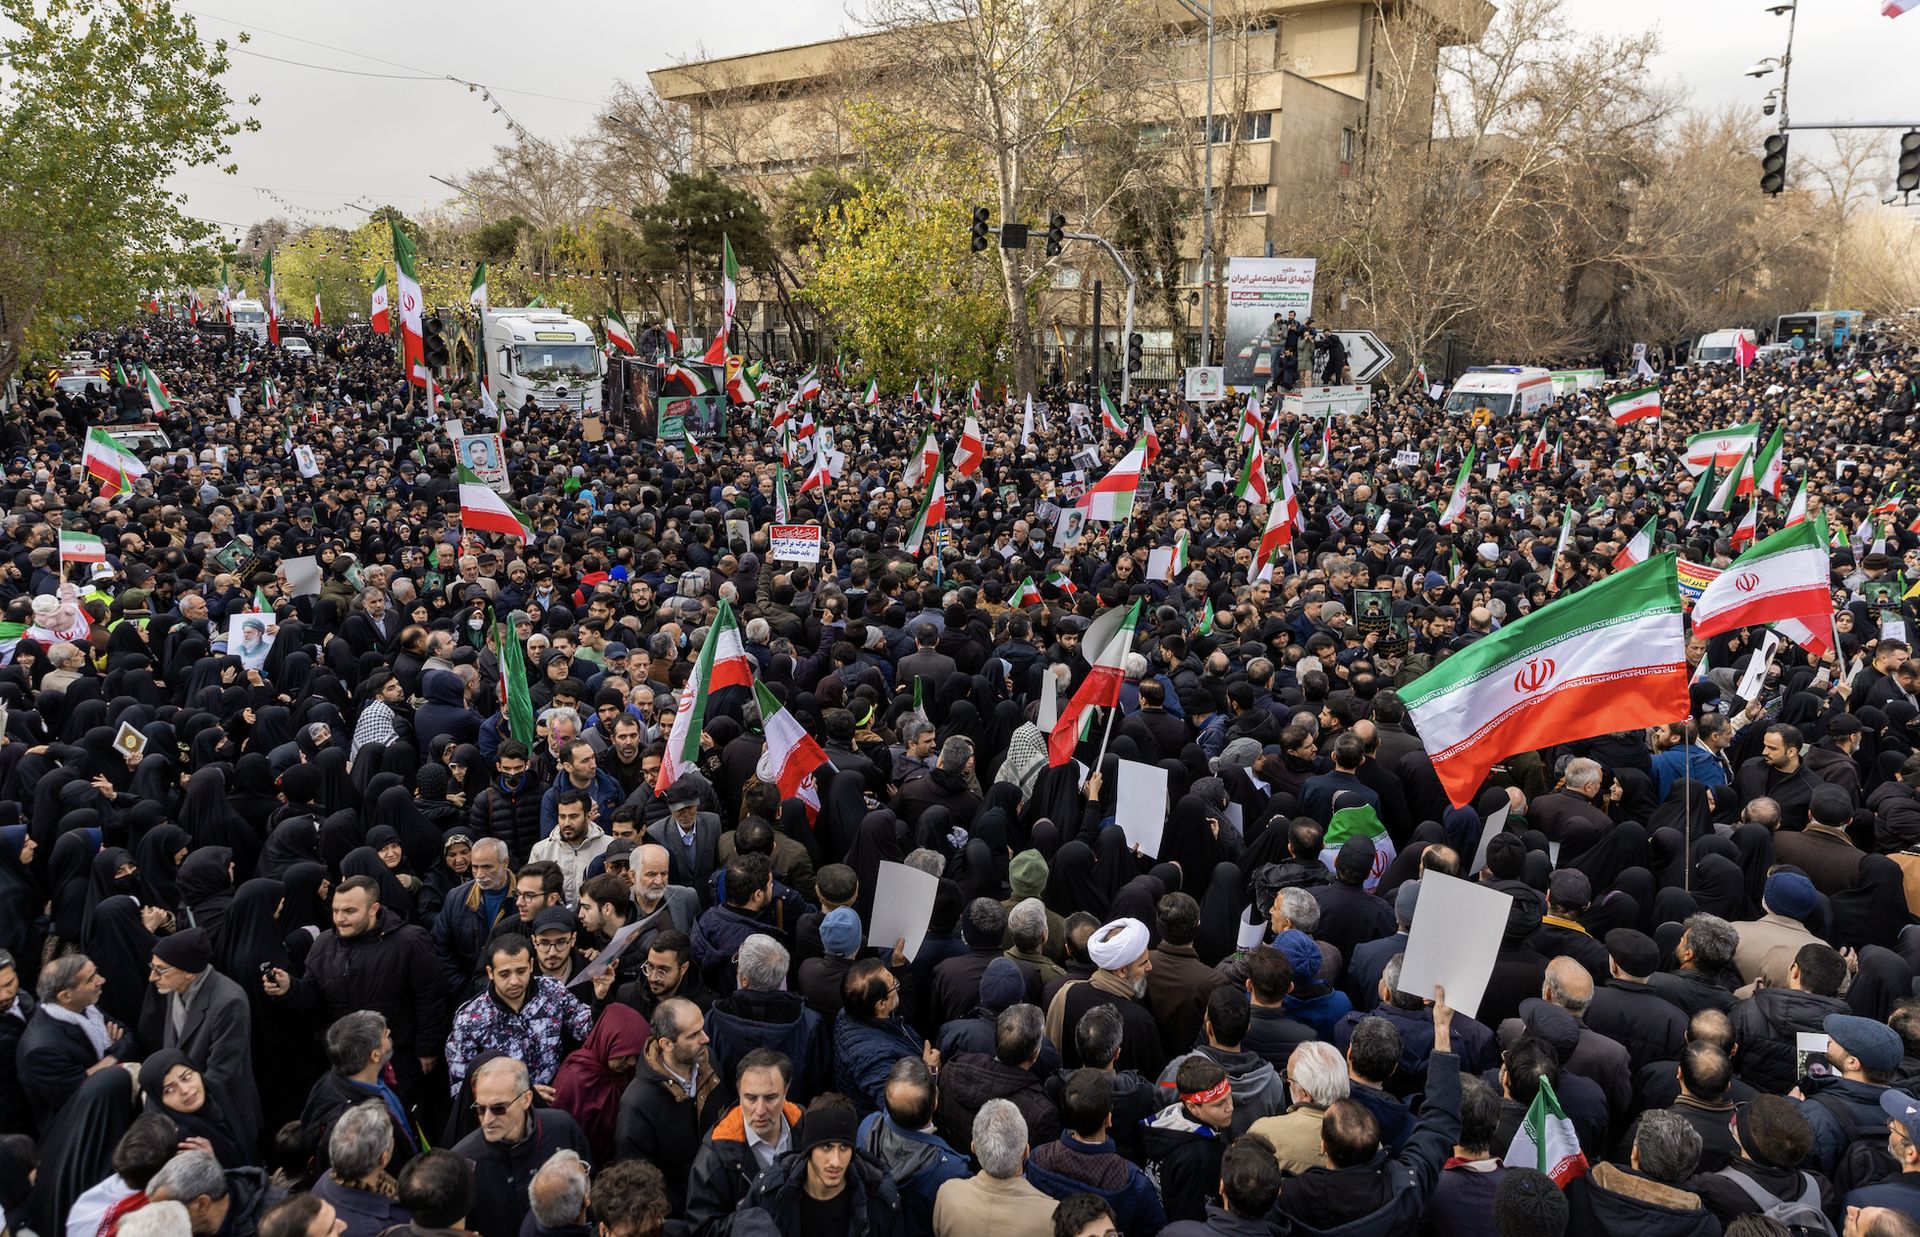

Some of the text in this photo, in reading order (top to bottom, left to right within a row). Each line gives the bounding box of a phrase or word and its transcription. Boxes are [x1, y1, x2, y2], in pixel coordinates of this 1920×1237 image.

[1232, 273, 1312, 284] شهدای مقاومت ملی ایران
